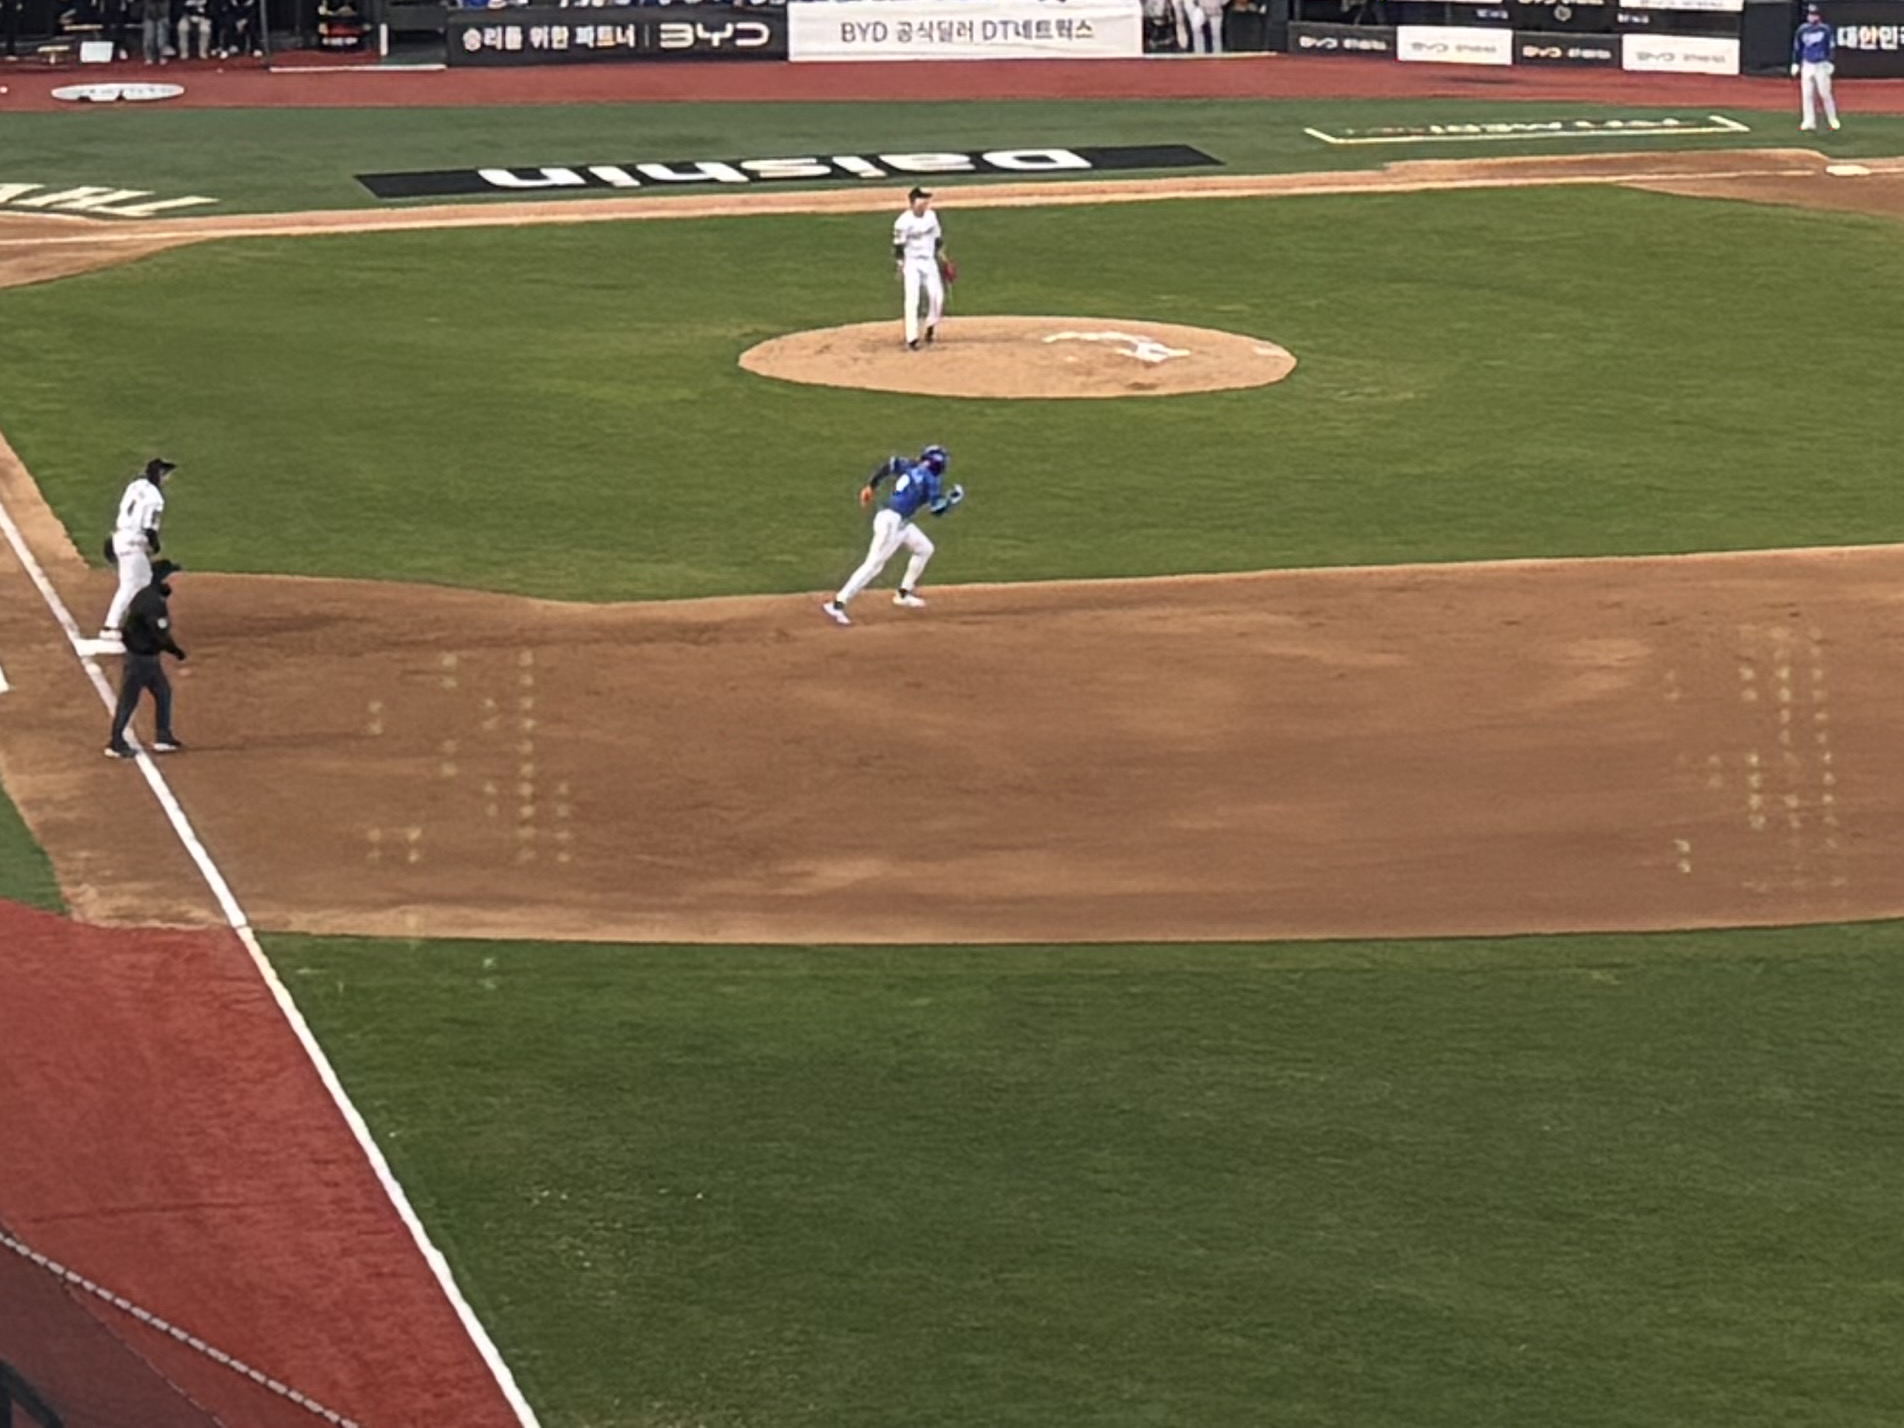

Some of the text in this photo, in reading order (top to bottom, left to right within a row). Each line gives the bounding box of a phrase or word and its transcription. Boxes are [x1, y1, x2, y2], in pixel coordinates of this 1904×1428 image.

[462, 22, 771, 52] 승리를 위한 파트너 BYD
[840, 21, 888, 43] BYD
[895, 20, 974, 43] 공식딜러
